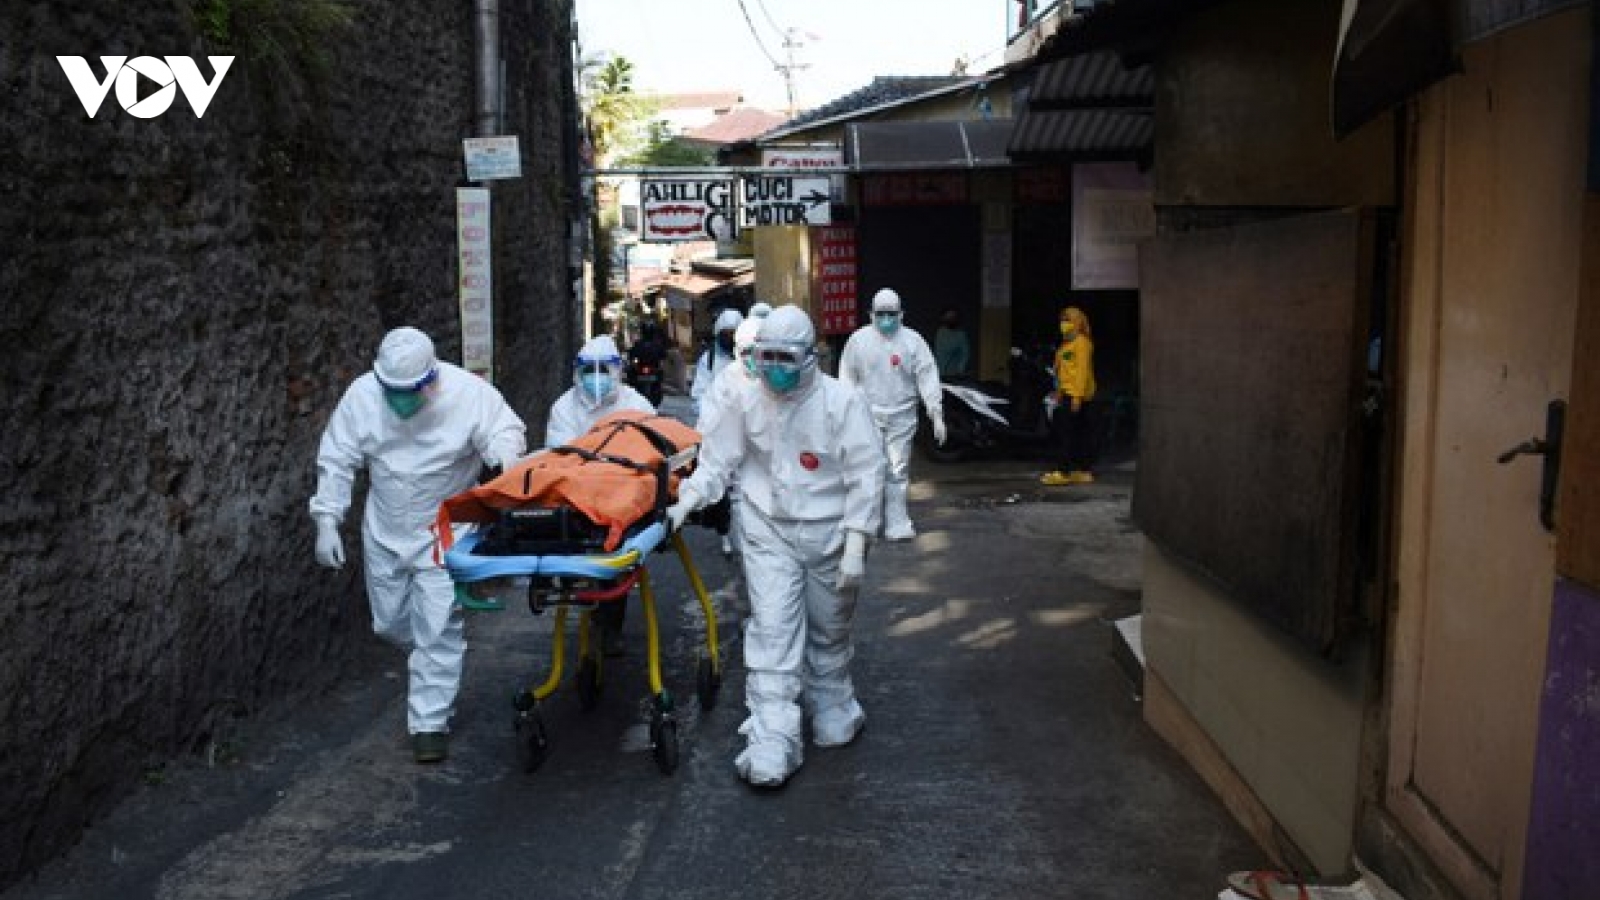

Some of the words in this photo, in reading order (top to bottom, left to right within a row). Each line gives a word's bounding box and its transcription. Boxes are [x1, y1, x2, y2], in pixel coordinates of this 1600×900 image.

[644, 182, 703, 201] AHLI
[746, 176, 793, 202] CUCI
[746, 203, 809, 226] MOTOR
